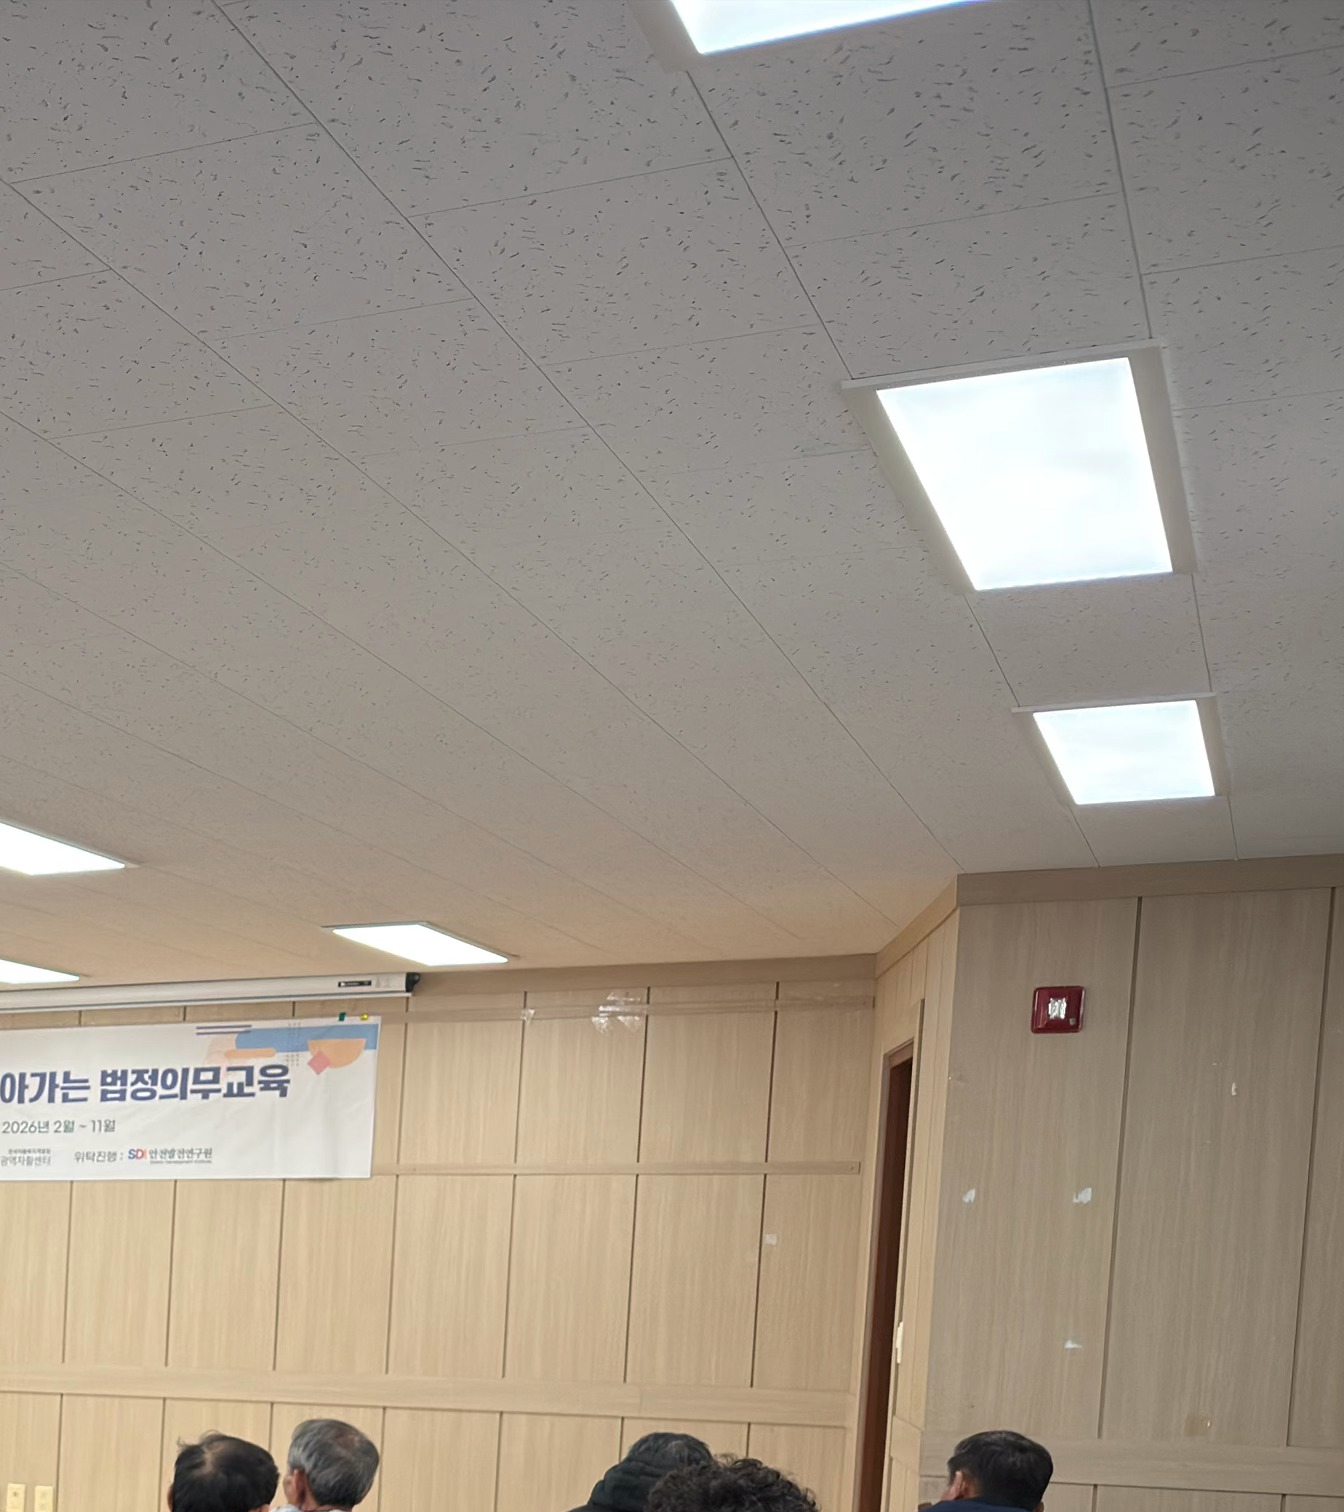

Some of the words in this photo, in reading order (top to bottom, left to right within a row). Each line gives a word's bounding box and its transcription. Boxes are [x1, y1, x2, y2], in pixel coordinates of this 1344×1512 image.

[100, 1064, 291, 1102] 법정의무교육
[1, 1120, 50, 1134] 2026년
[53, 1120, 75, 1133] 2월
[91, 1119, 116, 1133] 11월
[74, 1151, 117, 1163] 위탁진행
[128, 1149, 147, 1160] SDI
